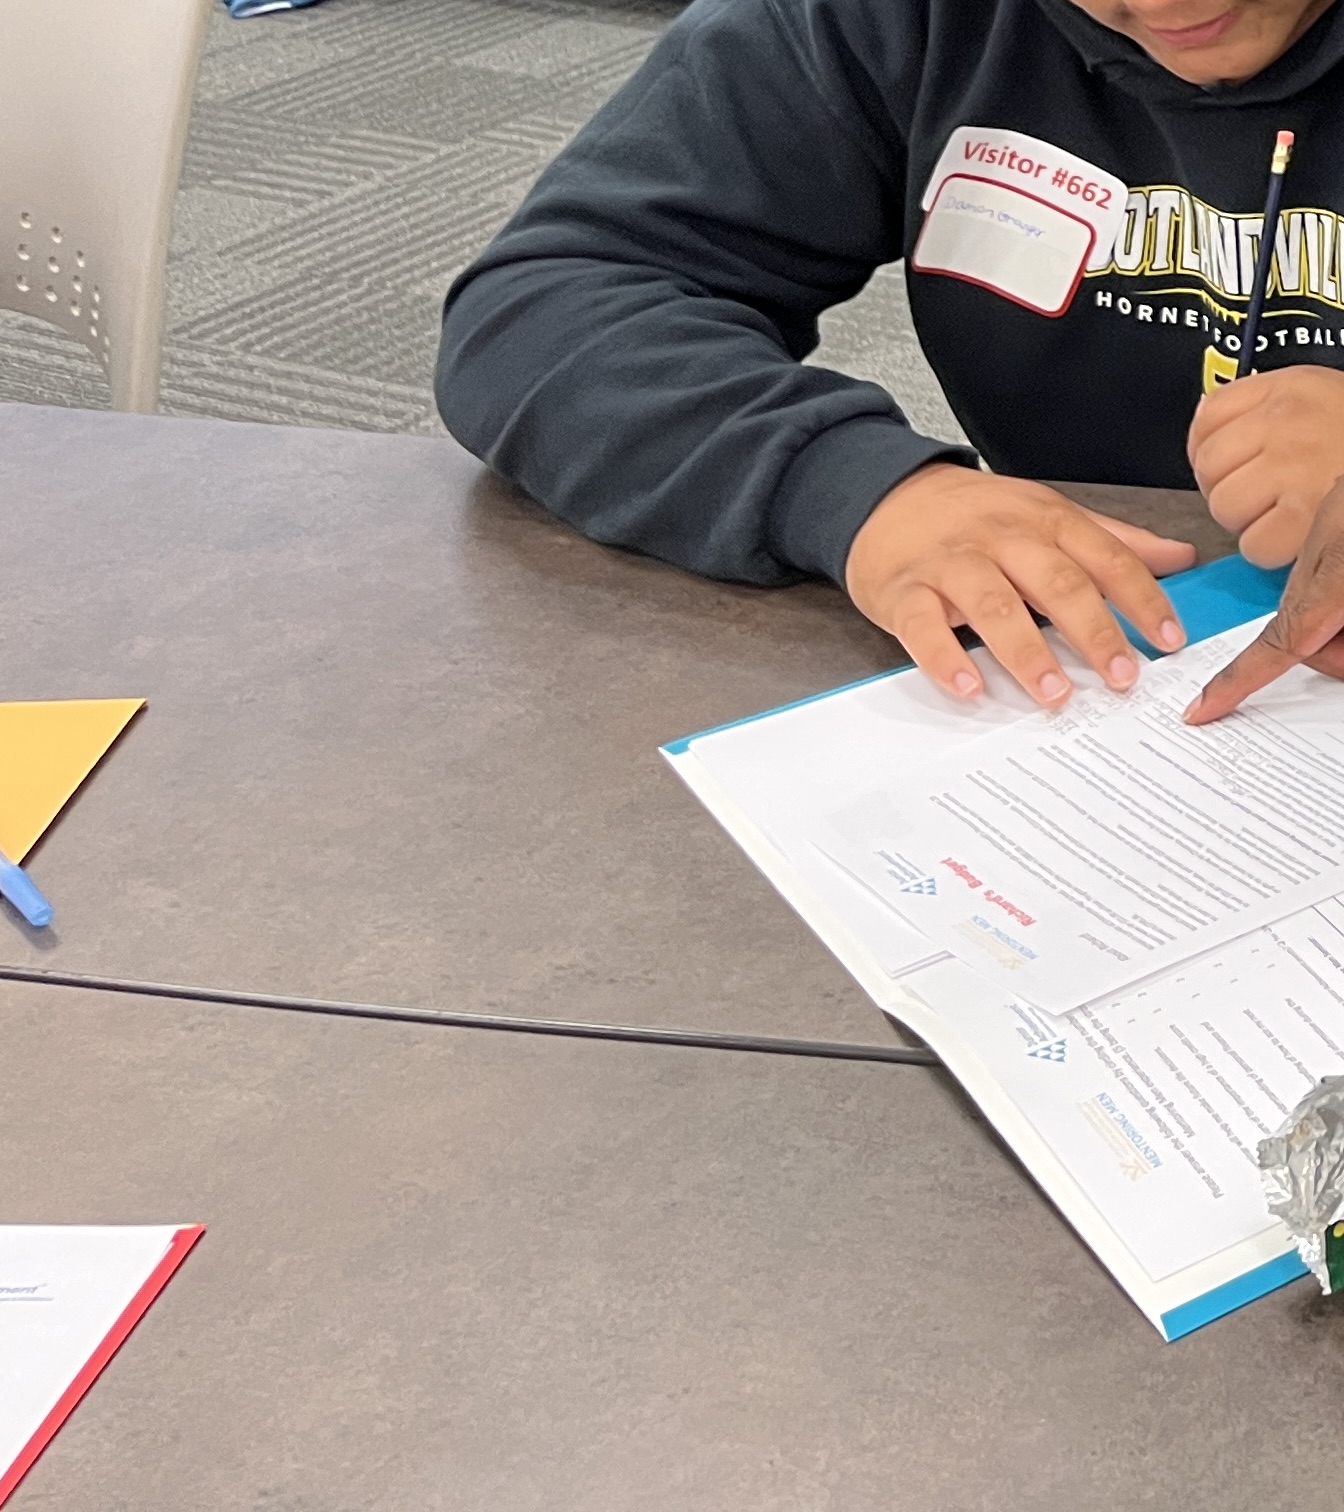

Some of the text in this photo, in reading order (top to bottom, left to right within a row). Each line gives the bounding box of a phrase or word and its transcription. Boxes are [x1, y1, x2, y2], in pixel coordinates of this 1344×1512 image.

[964, 141, 1113, 210] Visitor #662
[1093, 1091, 1164, 1169] MENTORING MEN
